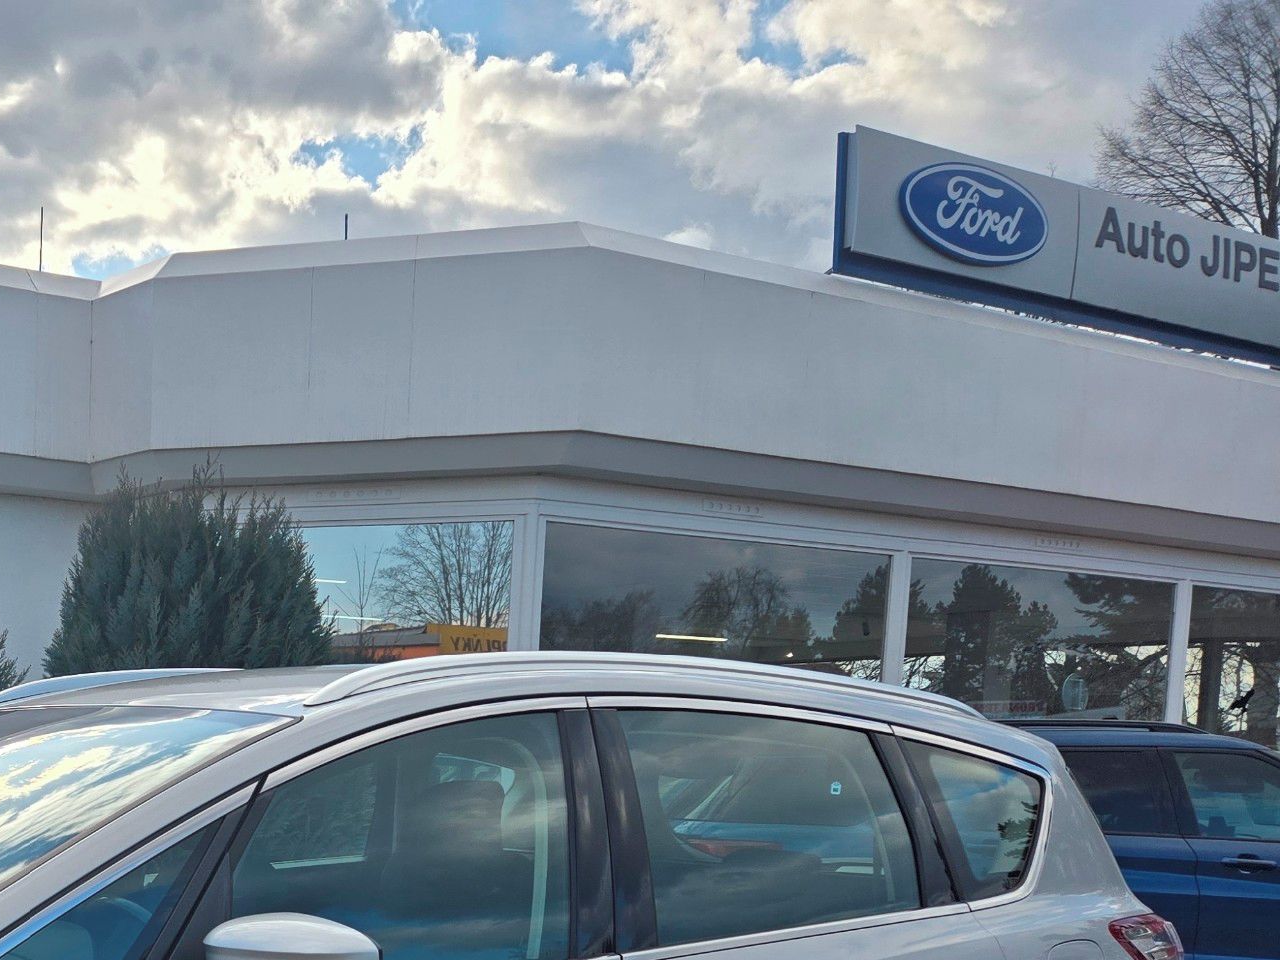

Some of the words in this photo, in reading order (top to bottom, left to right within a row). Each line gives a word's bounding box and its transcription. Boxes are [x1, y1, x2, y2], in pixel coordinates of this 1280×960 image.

[936, 174, 1024, 246] Ford
[1095, 206, 1190, 269] Auto
[1200, 234, 1280, 293] JIPE
